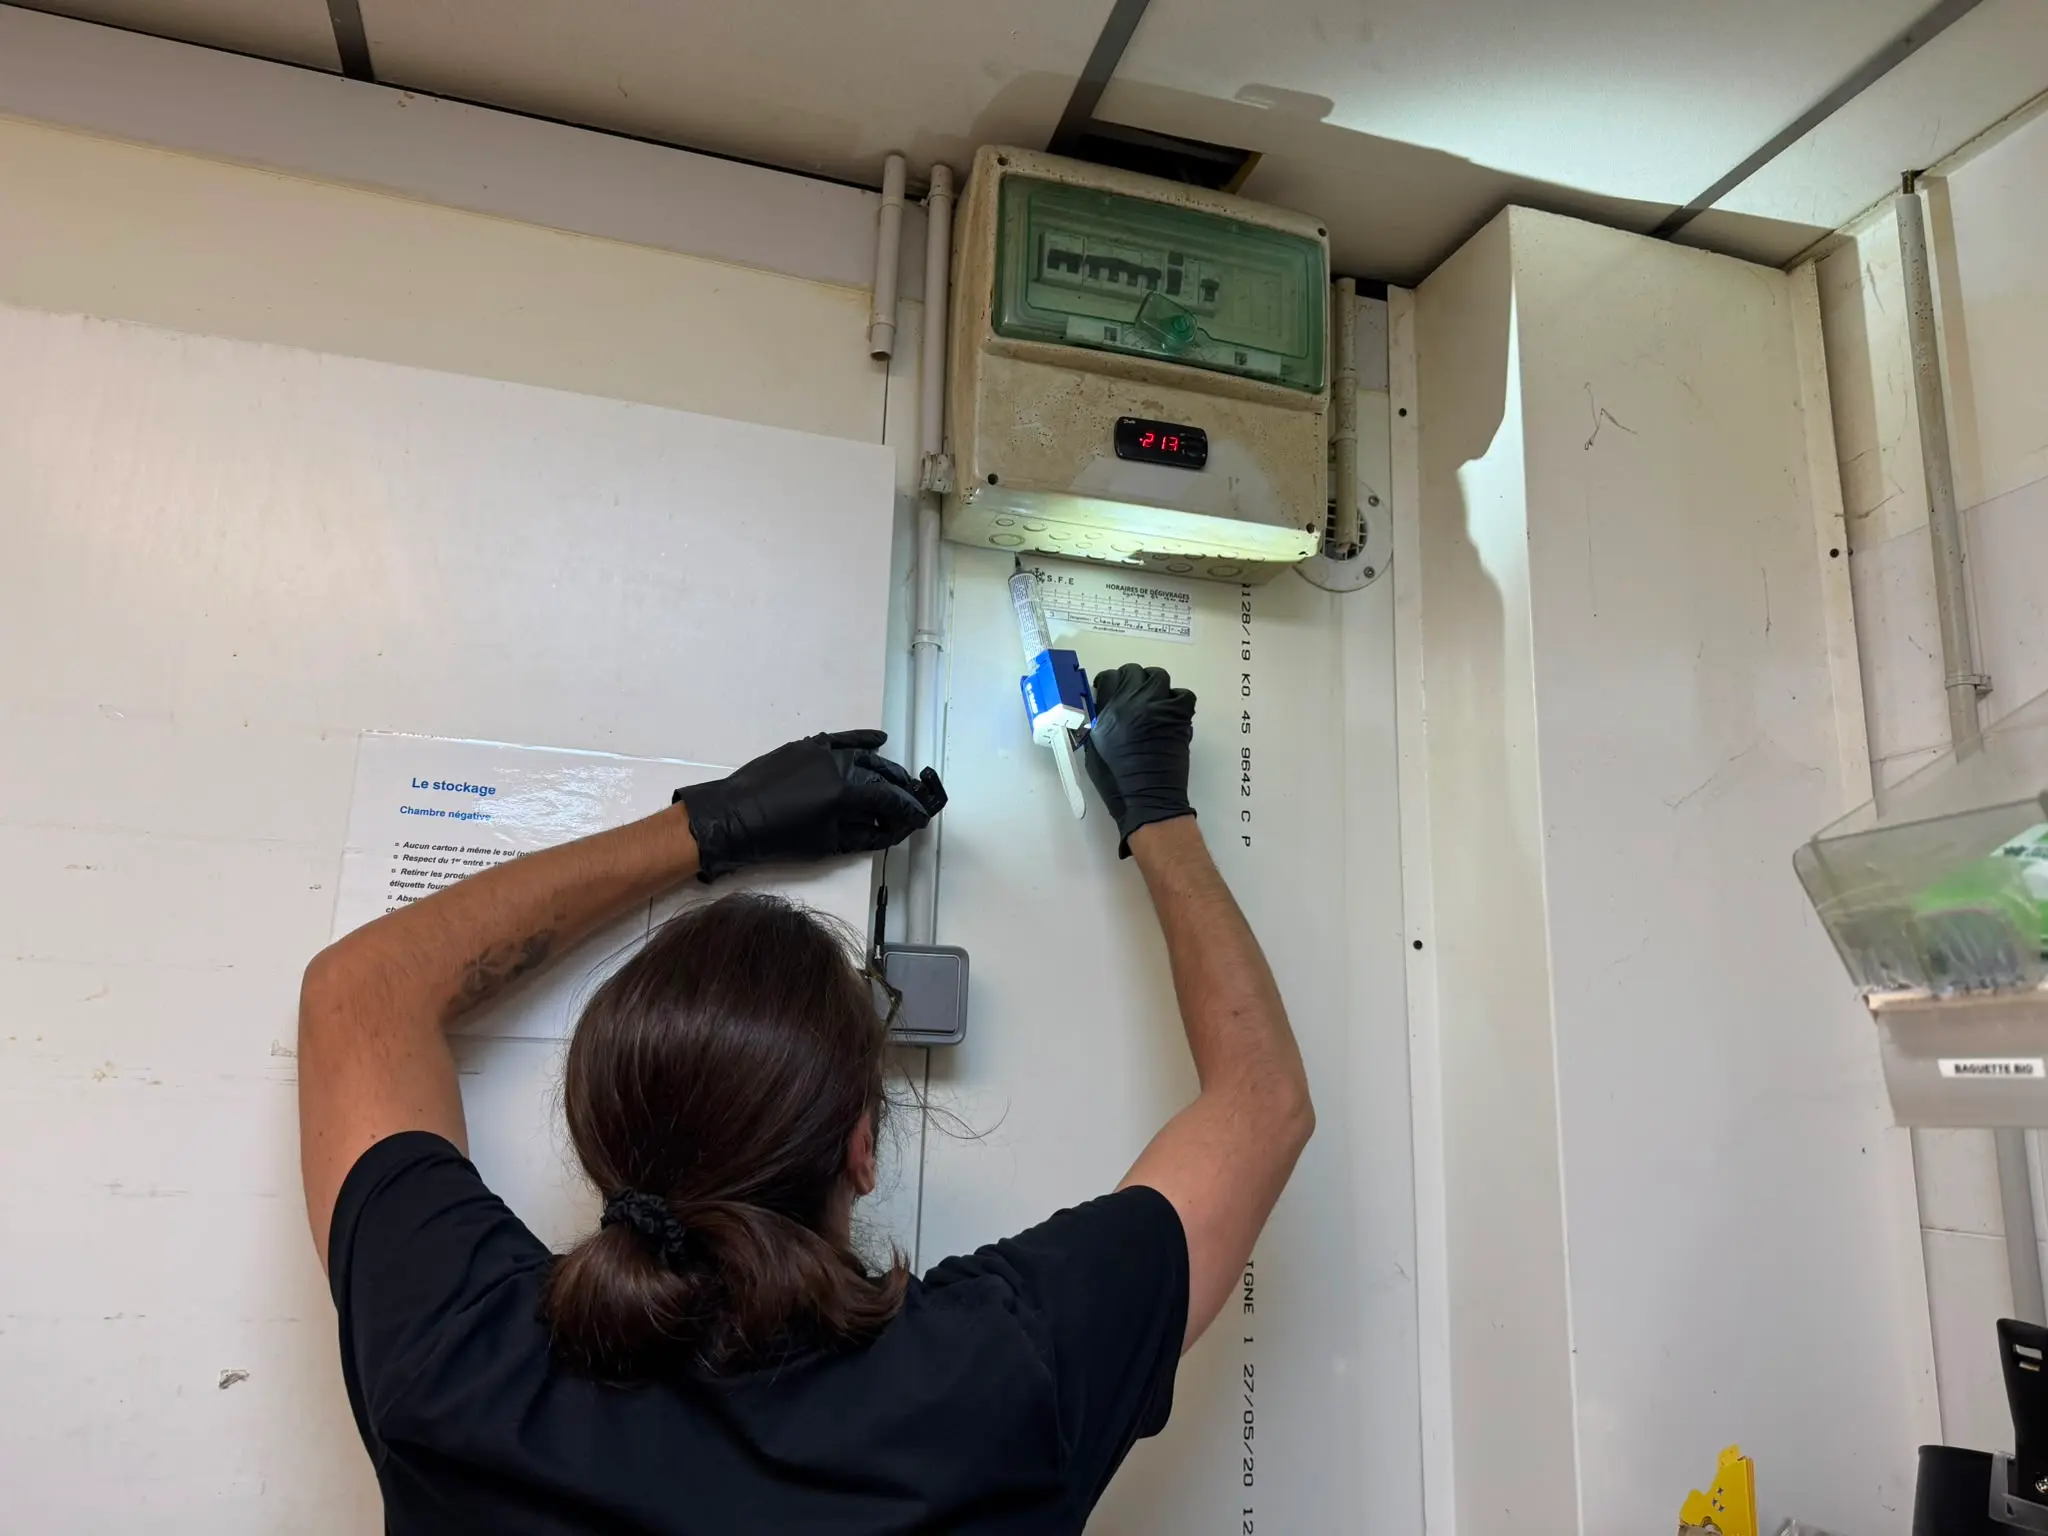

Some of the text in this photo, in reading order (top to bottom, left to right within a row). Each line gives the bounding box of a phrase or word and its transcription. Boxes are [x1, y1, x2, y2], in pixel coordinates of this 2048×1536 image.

[1105, 583, 1139, 594] HORAIRES
[1139, 587, 1148, 595] DE
[1149, 588, 1190, 601] DÉGIVRAGES
[1241, 710, 1251, 734] 45
[1241, 747, 1251, 797] 9642
[411, 777, 496, 797] Le stockage
[399, 805, 446, 817] Chambre
[1241, 810, 1251, 823] C
[1241, 836, 1251, 847] P
[402, 841, 430, 850] Aucun
[431, 844, 458, 852] carton
[466, 846, 492, 855] même
[502, 849, 516, 857] sol
[402, 854, 436, 864] Respect
[400, 867, 429, 877] Retirer
[430, 870, 443, 878] les
[389, 880, 426, 889] étiquette
[1954, 1063, 2011, 1075] BAGUETTE
[1243, 1336, 1254, 1344] 1
[1243, 1363, 1255, 1488] 27/05/20
[1242, 1507, 1254, 1536] 12
